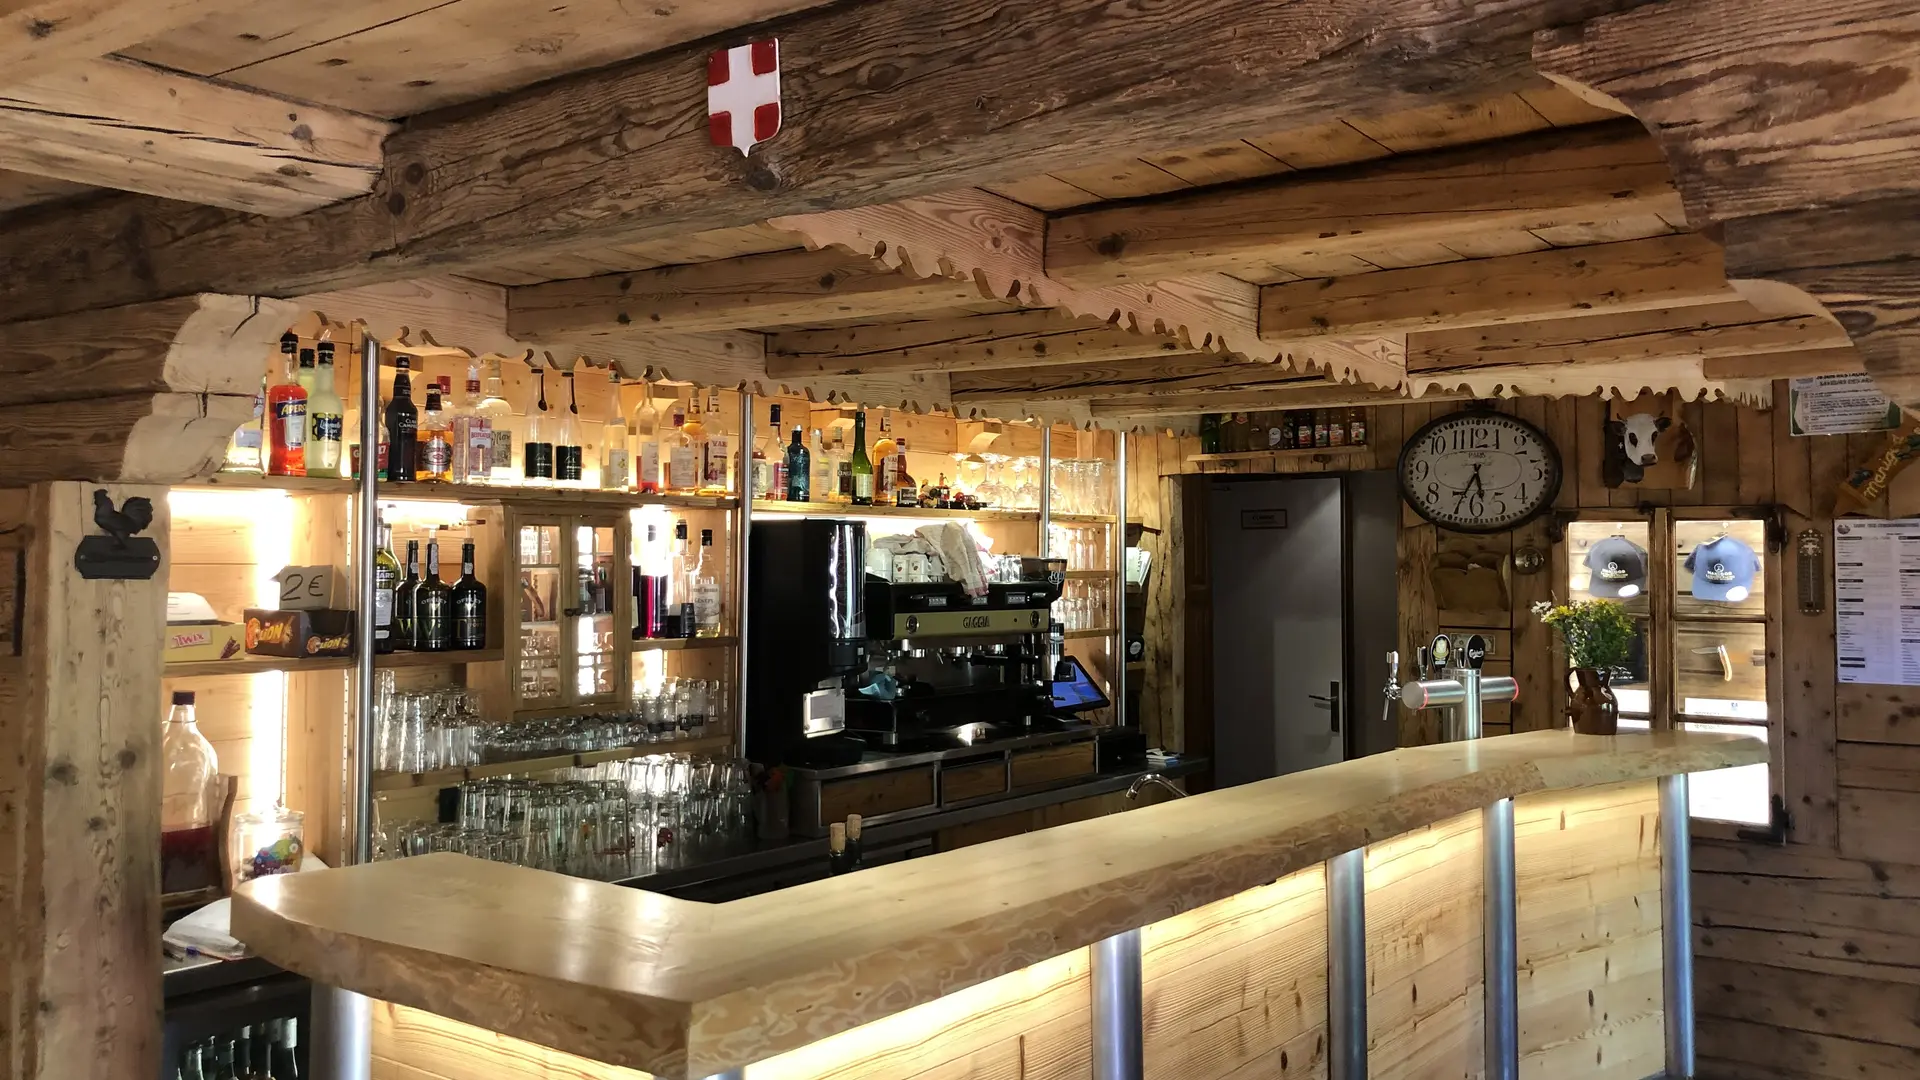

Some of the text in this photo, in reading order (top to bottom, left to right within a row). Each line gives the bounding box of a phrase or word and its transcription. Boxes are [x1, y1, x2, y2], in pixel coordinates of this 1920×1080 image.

[281, 404, 306, 416] APERO
[1513, 435, 1528, 455] 2
[1415, 460, 1429, 483] 9
[1529, 459, 1543, 481] 3
[1425, 482, 1440, 505] 8
[1513, 482, 1528, 505] 4
[963, 616, 990, 628] GAGGIA
